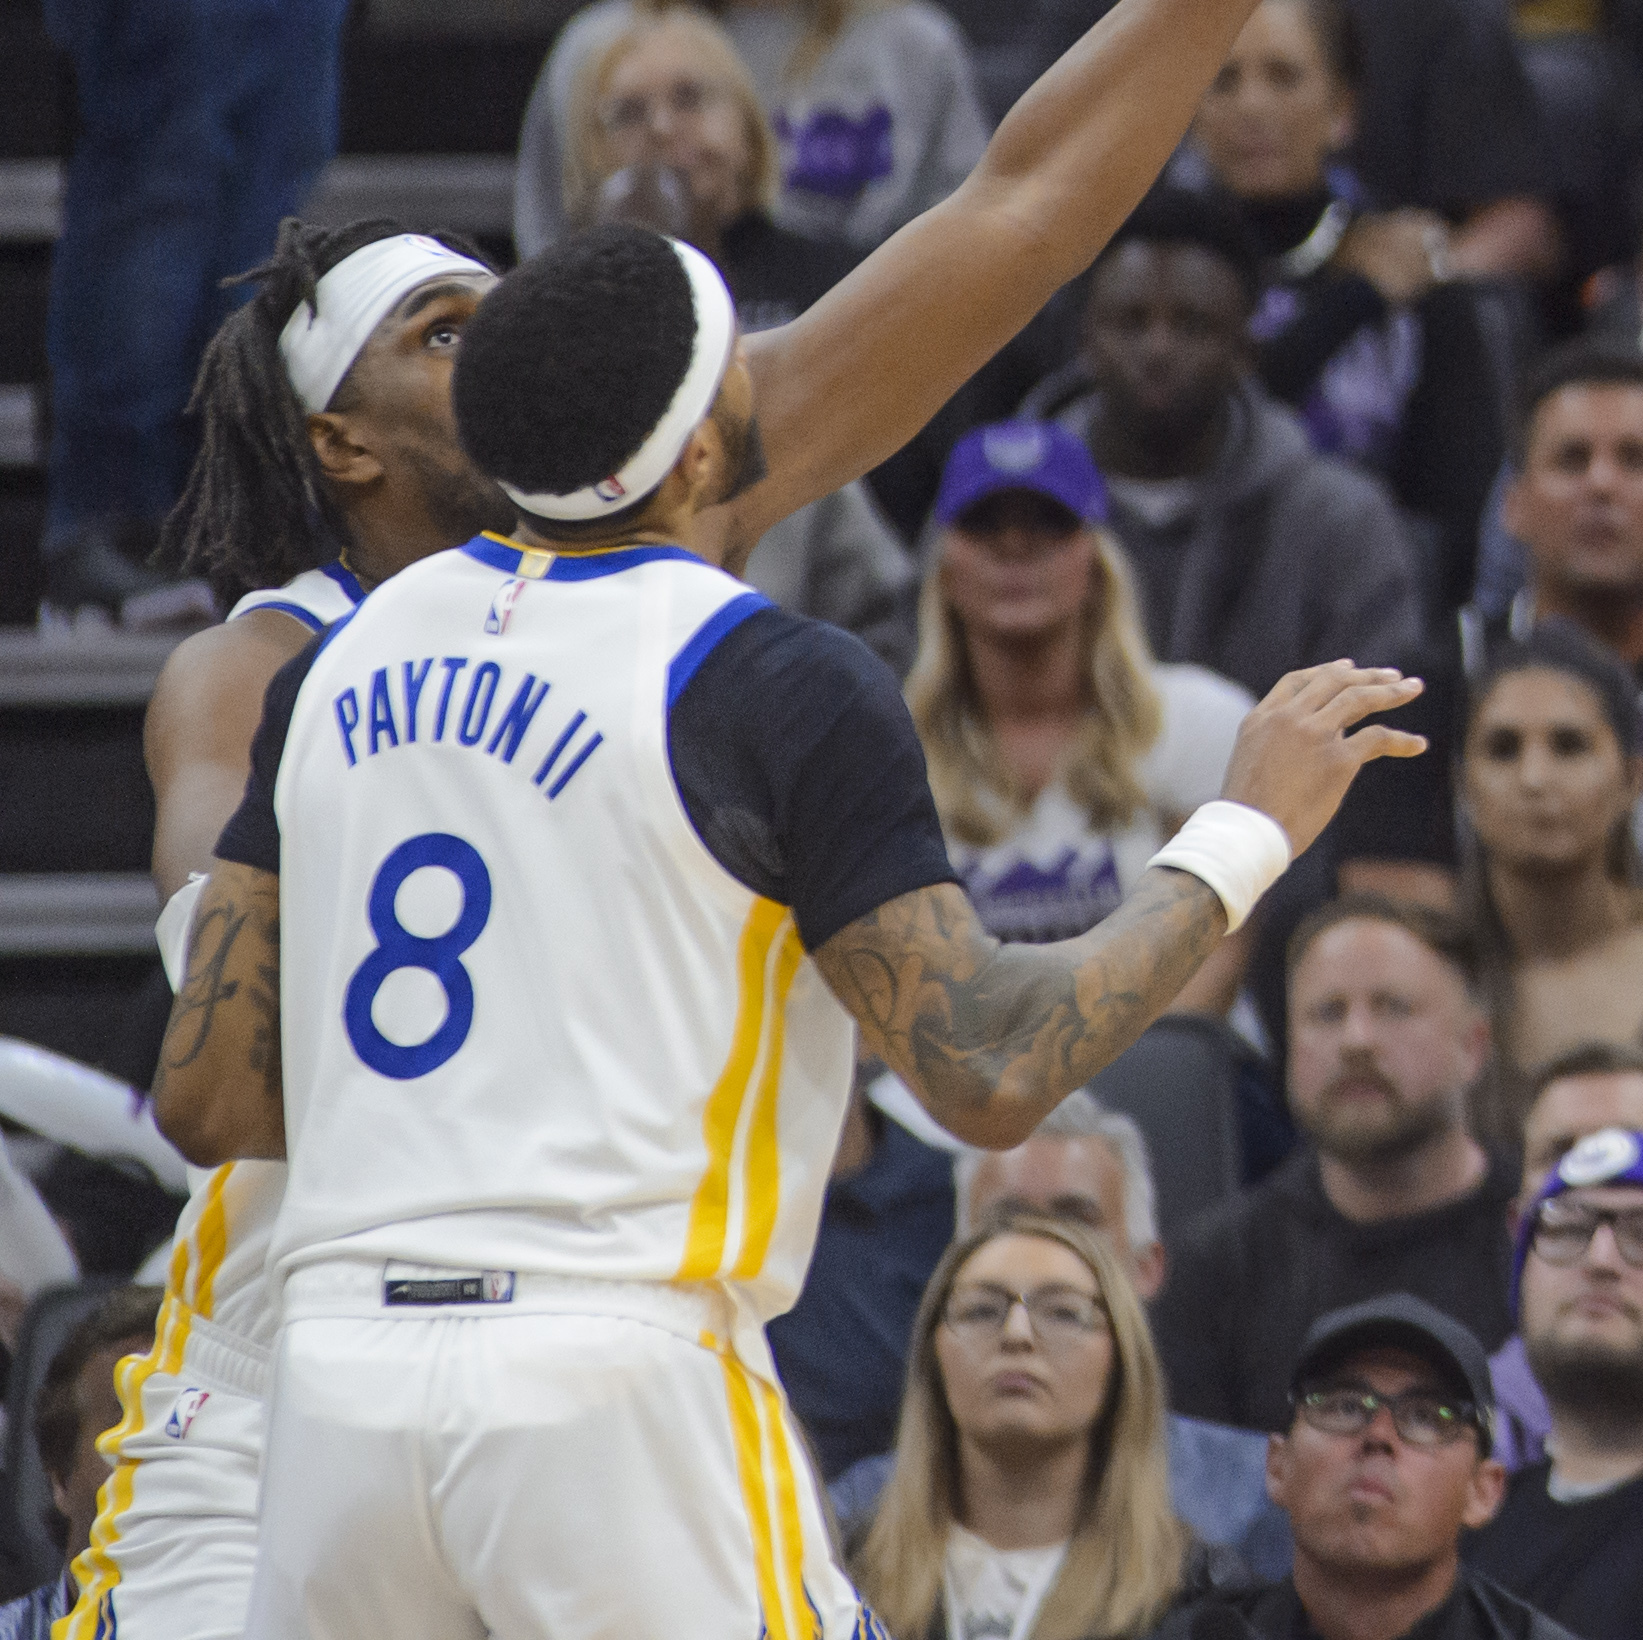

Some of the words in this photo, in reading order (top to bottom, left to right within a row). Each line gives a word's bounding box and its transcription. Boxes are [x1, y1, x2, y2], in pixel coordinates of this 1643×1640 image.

[333, 658, 551, 769] PAYTON
[530, 709, 604, 803] II
[341, 831, 492, 1082] 8
